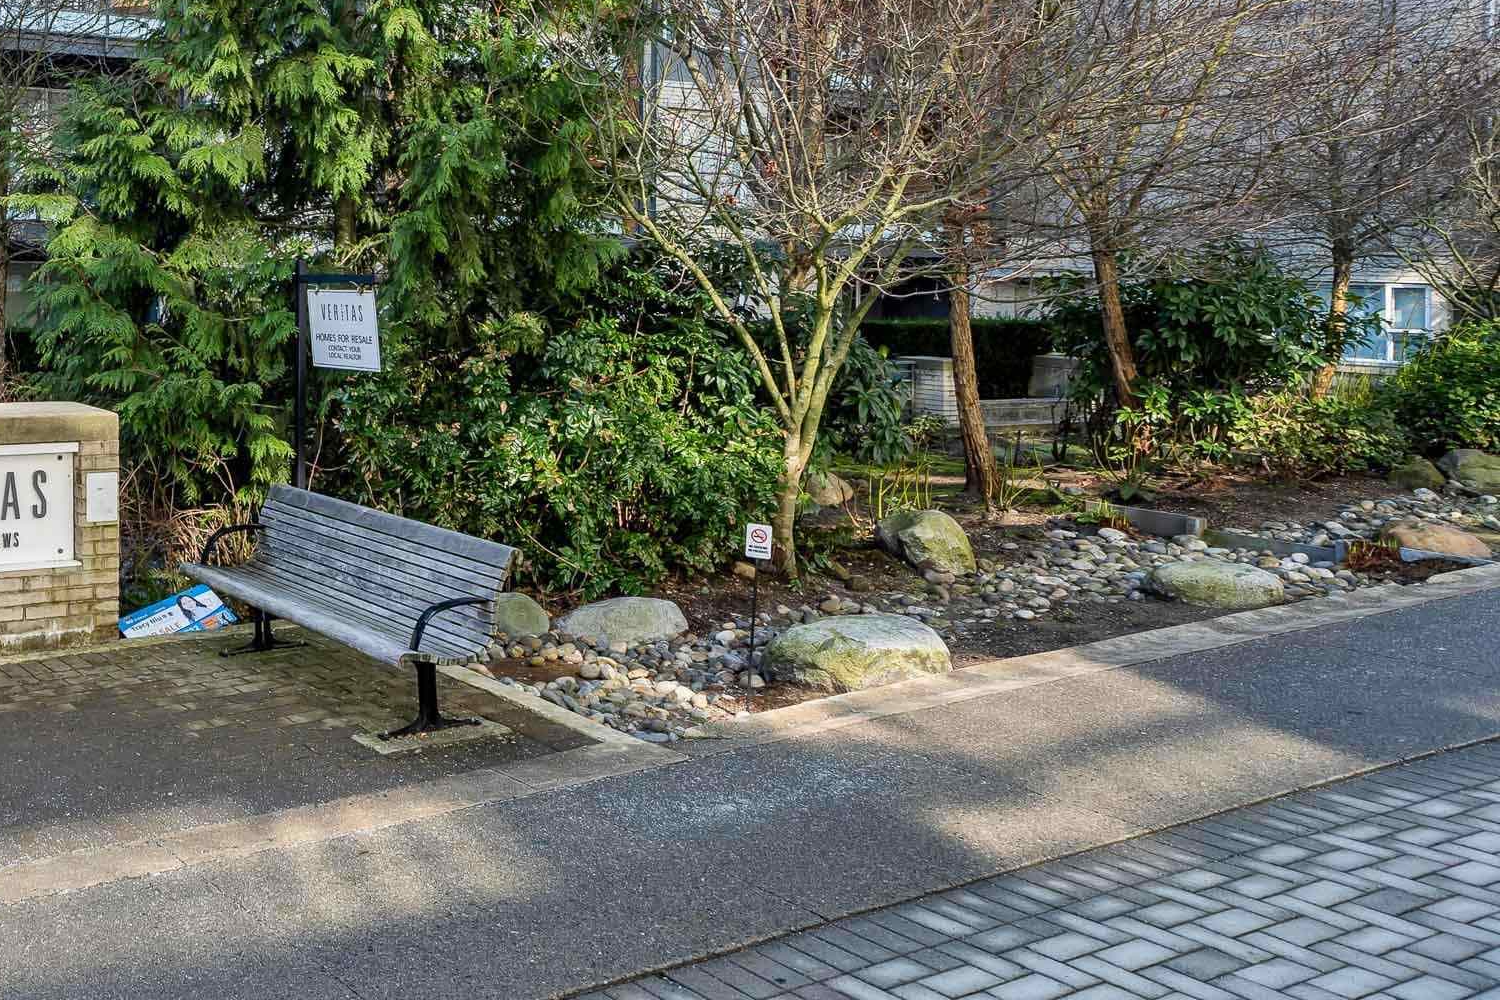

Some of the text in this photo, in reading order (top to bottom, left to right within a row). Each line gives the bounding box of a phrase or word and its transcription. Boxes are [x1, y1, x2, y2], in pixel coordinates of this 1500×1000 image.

[320, 303, 363, 322] VERITAS
[315, 333, 373, 344] HOMES FOR RESALE
